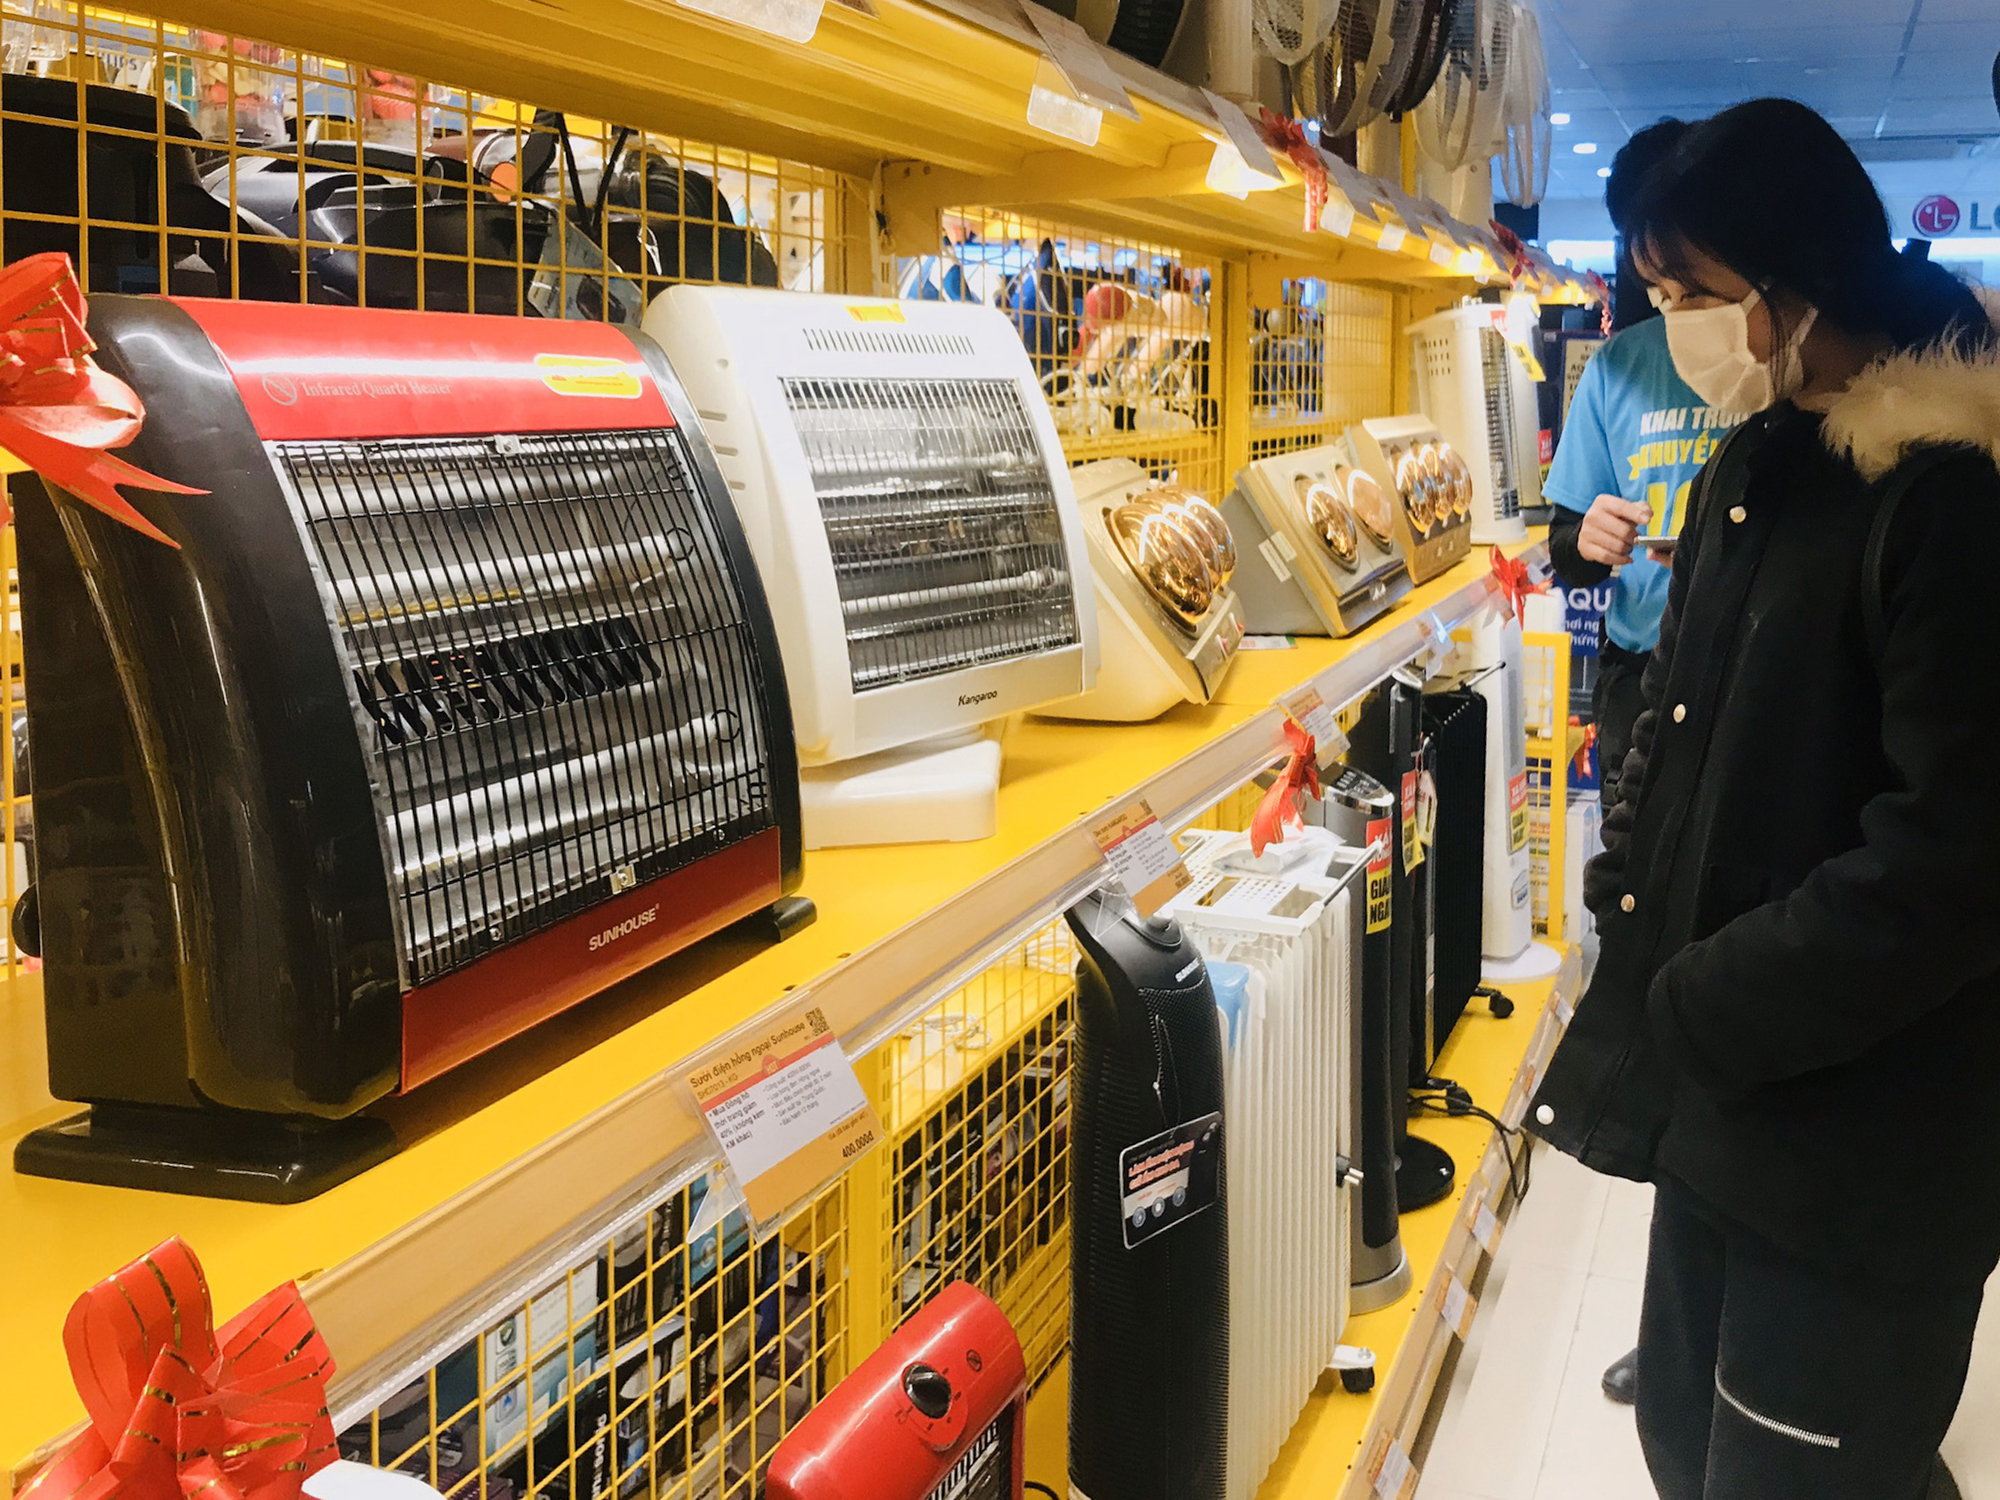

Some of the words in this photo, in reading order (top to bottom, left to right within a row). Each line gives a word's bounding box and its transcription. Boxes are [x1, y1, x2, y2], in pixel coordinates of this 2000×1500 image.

[300, 382, 361, 396] Infrared
[362, 381, 409, 398] Quartz
[408, 381, 451, 395] Heater
[1640, 408, 1688, 436] KHAI
[958, 690, 998, 706] Kangaroo
[589, 907, 656, 951] SUNHOUSE
[770, 1022, 806, 1045] Sunhouse
